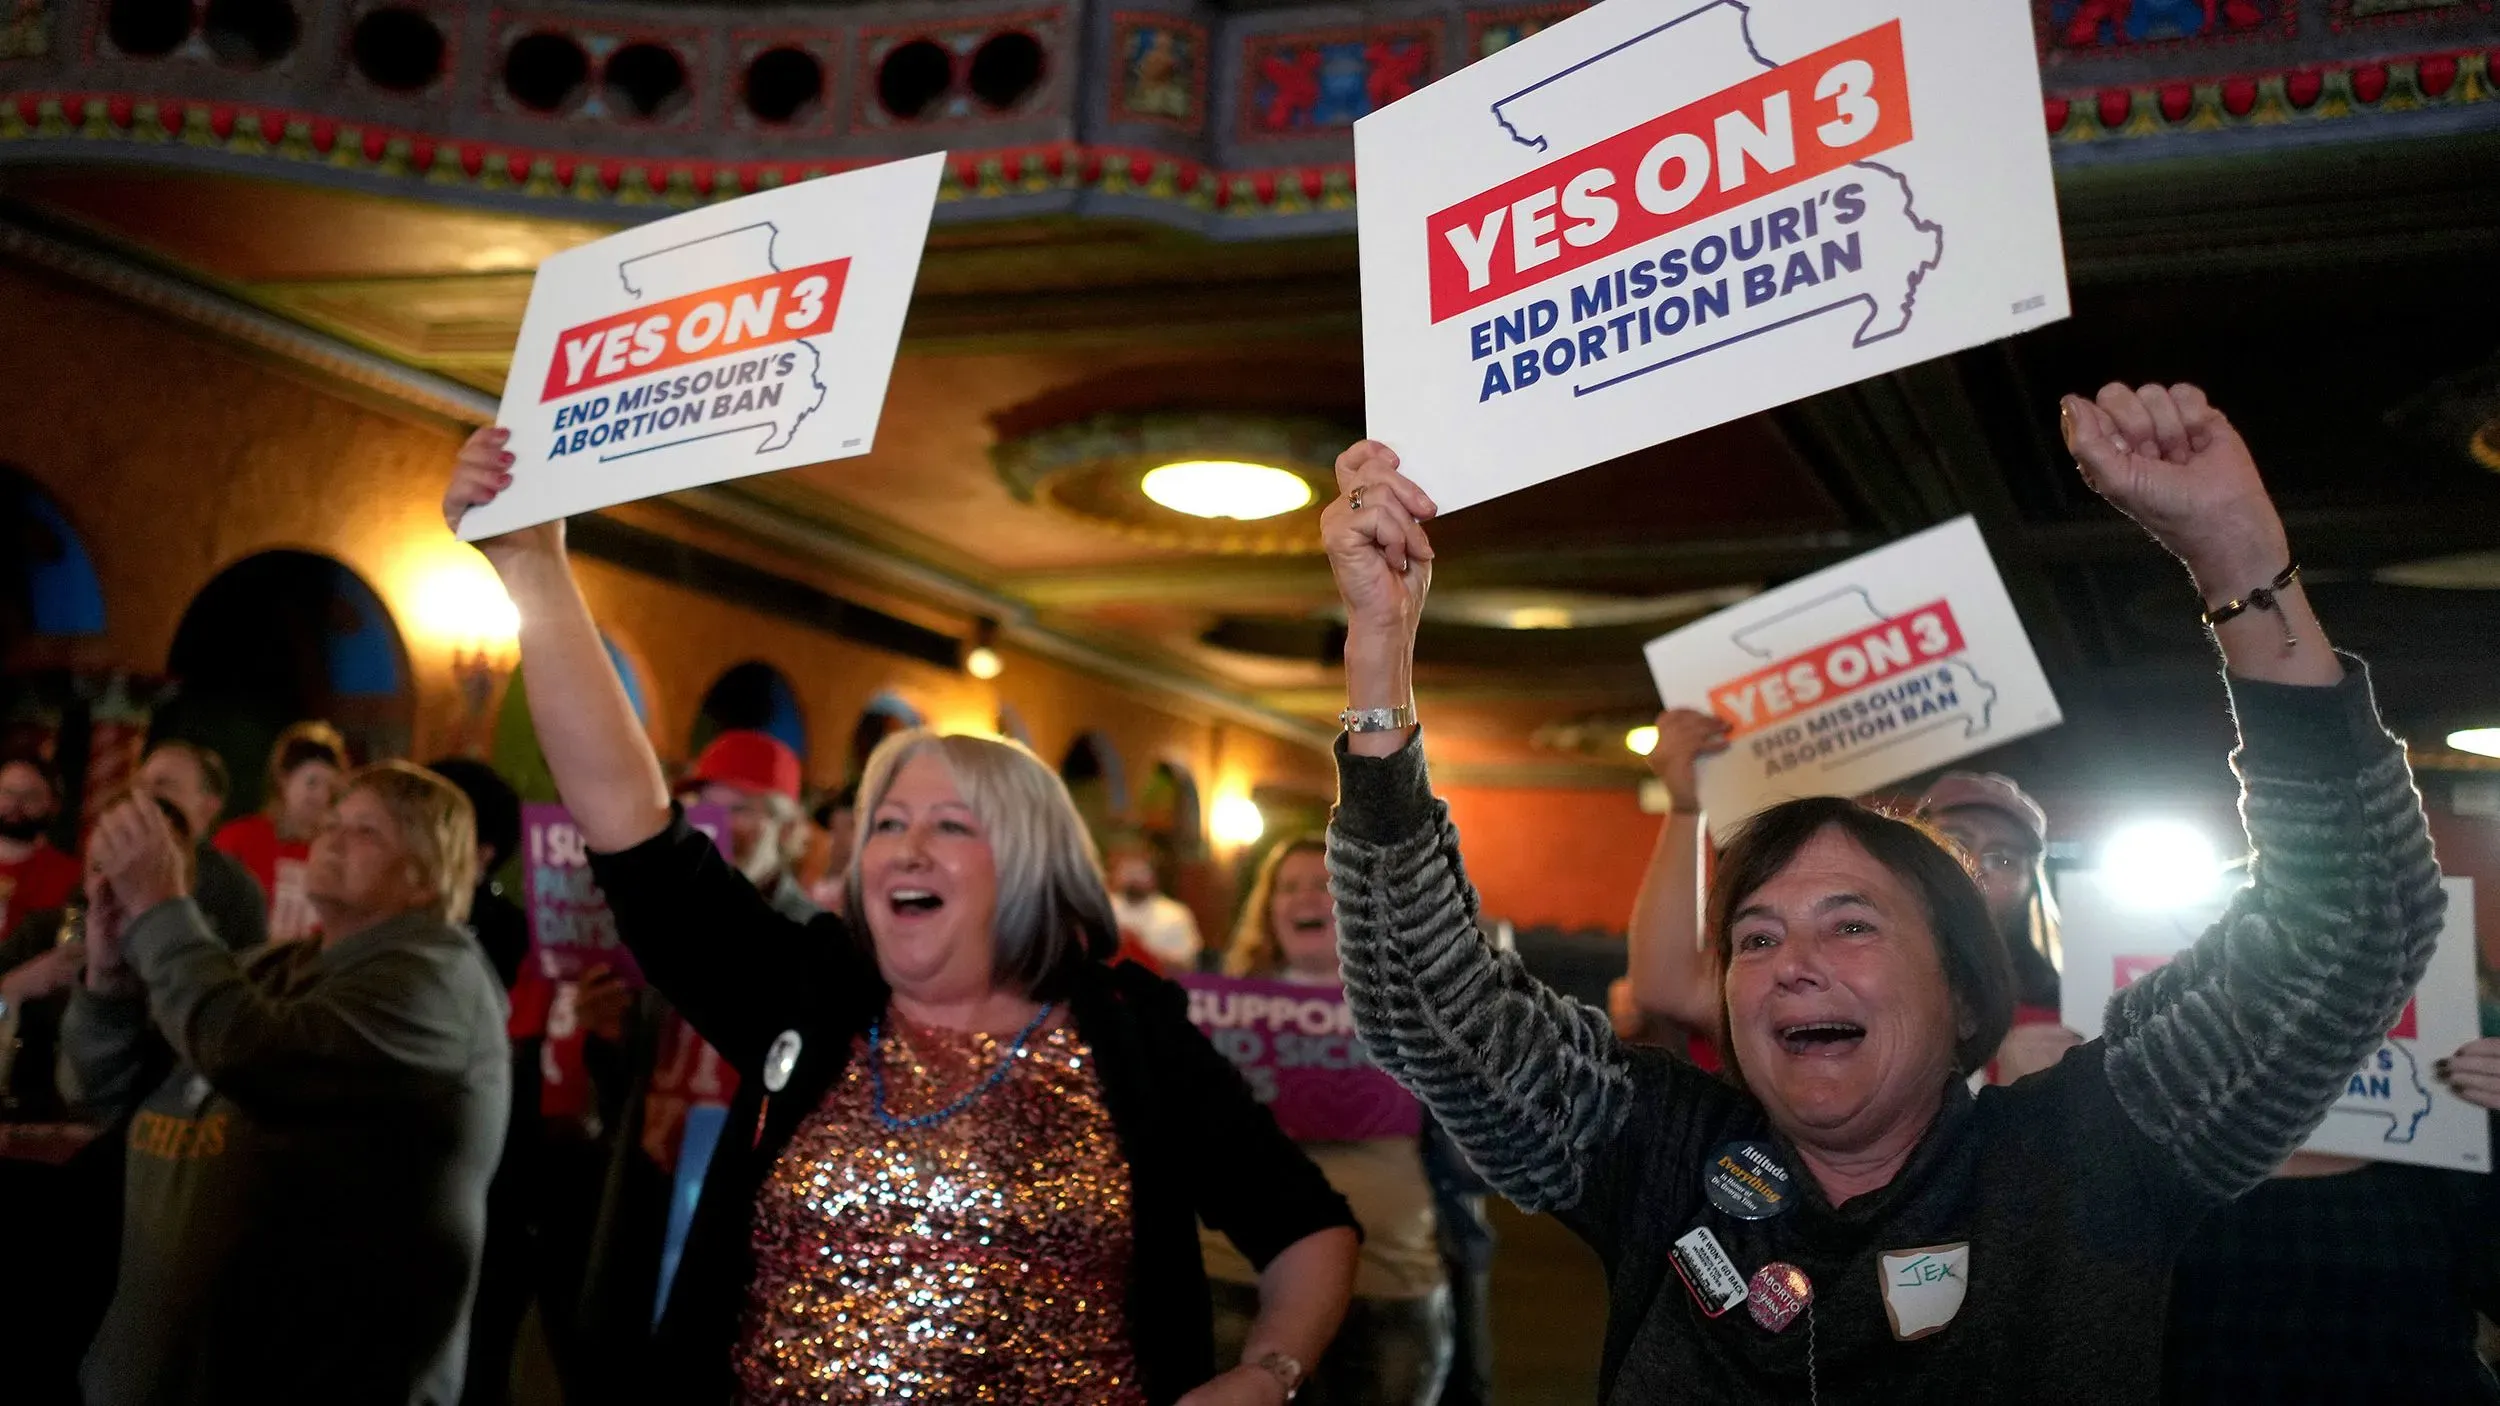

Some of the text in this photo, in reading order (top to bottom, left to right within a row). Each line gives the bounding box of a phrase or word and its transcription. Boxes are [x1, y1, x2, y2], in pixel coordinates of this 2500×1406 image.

[1445, 59, 1880, 292] YES ON 3
[1470, 182, 1866, 360] END MISSOURI'S
[564, 275, 829, 387] YES ON 3
[1479, 232, 1862, 402] ABORTION BAN
[547, 383, 784, 461] ABORTION BAN
[552, 352, 796, 433] END MISSOURI'S
[1722, 612, 1948, 726] YES ON 3
[1752, 666, 1953, 760] END MISSOURI'S
[1764, 689, 1960, 779] ABORTION BAN
[2348, 1073, 2391, 1099] AN
[1718, 1155, 1783, 1203] Everything
[1720, 1182, 1743, 1201] George
[1741, 1196, 1758, 1211] Tiller
[1727, 1175, 1746, 1193] Honor
[1741, 1145, 1788, 1181] Attitude
[1697, 1229, 1745, 1296] WE WON'T GO BACK
[1759, 1270, 1802, 1313] ABORTIO
